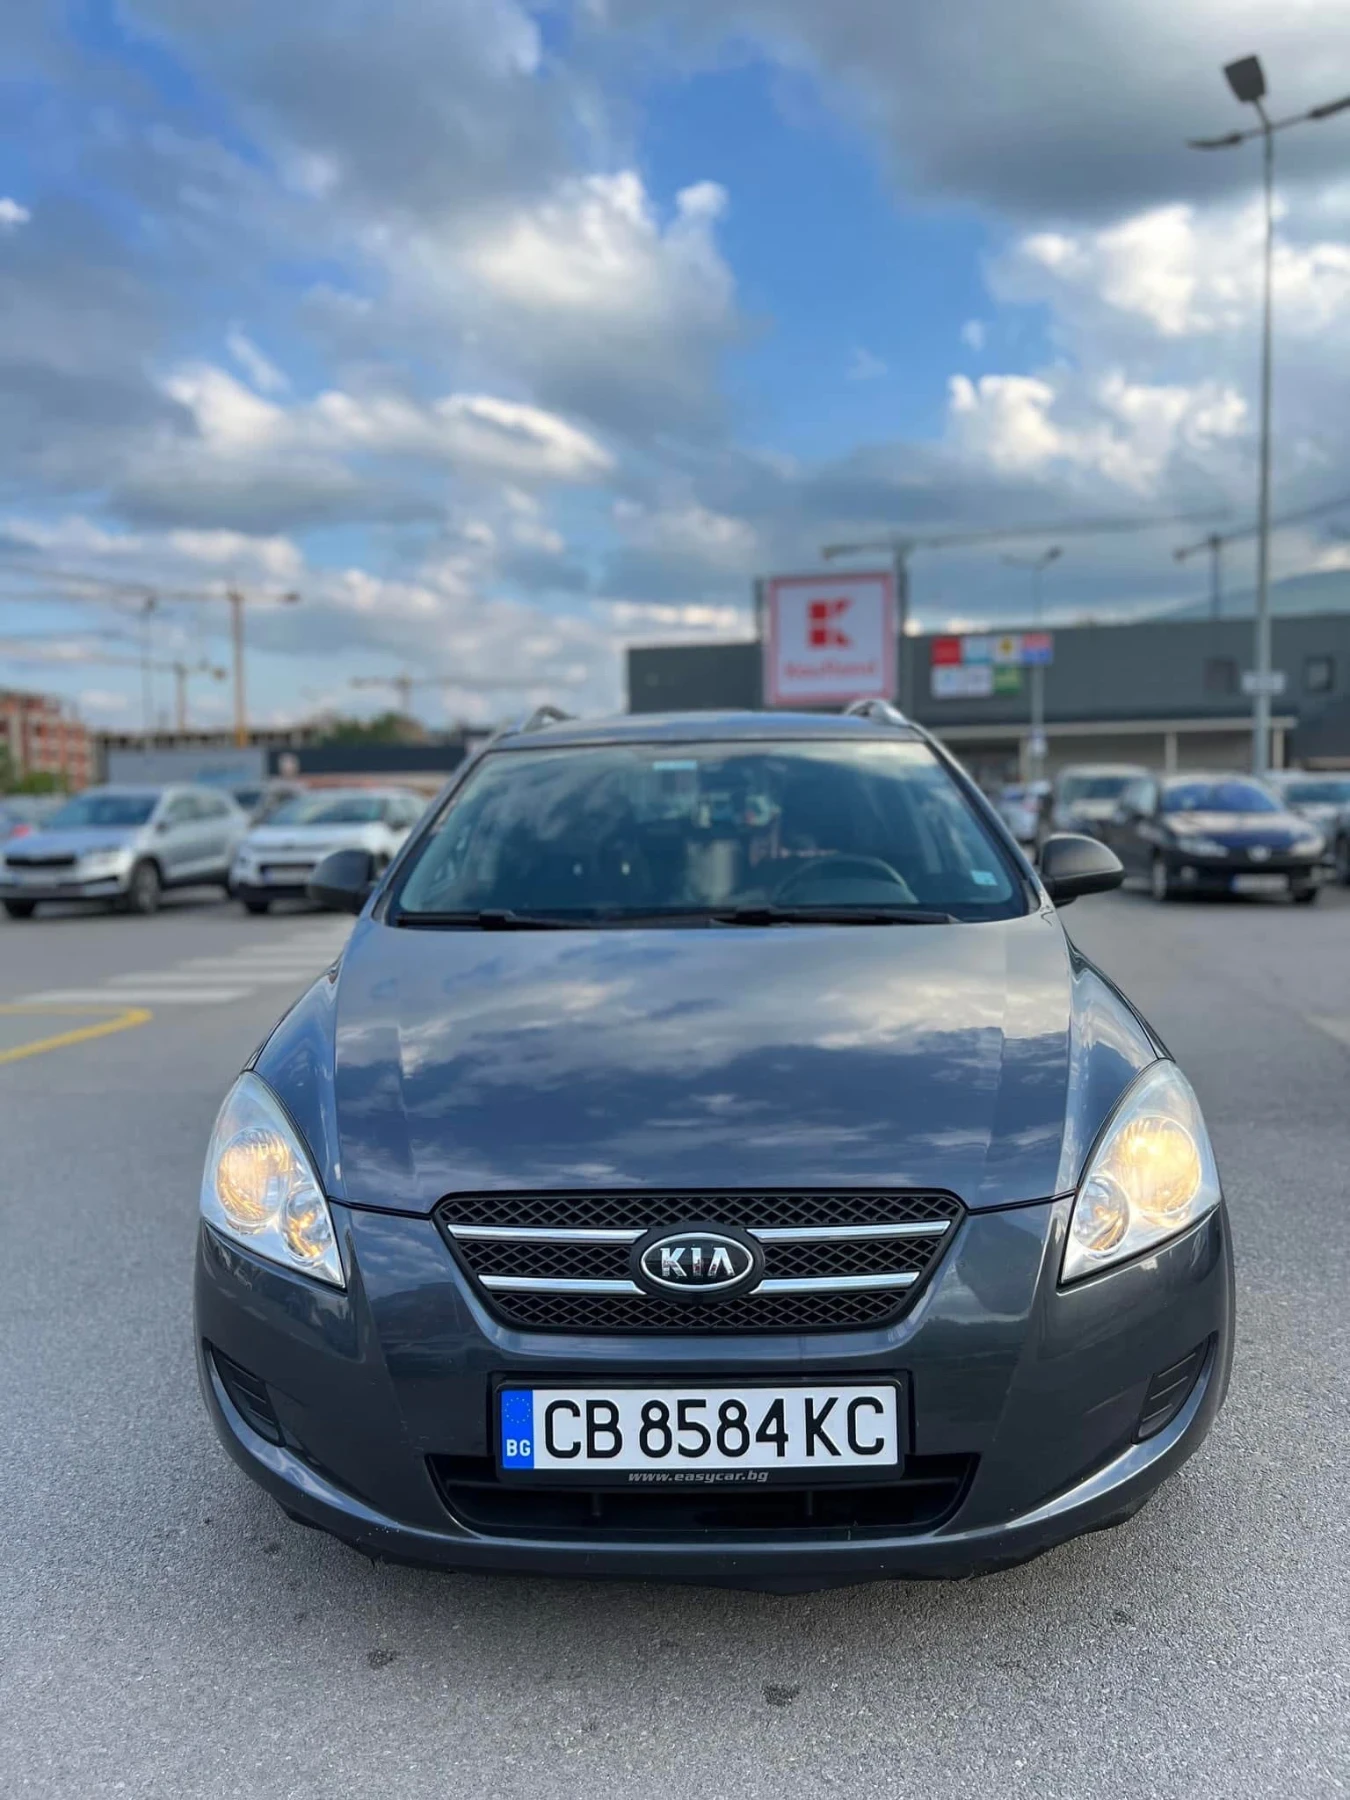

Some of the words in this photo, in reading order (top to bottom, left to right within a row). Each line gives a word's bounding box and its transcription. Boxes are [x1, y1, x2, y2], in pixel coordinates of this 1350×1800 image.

[808, 599, 853, 648] K
[660, 1247, 735, 1277] KIA
[544, 1399, 623, 1459] CB
[638, 1398, 789, 1458] 8584
[804, 1397, 885, 1457] KC
[506, 1439, 531, 1457] BG
[628, 1470, 769, 1484] www.easycar.bg
